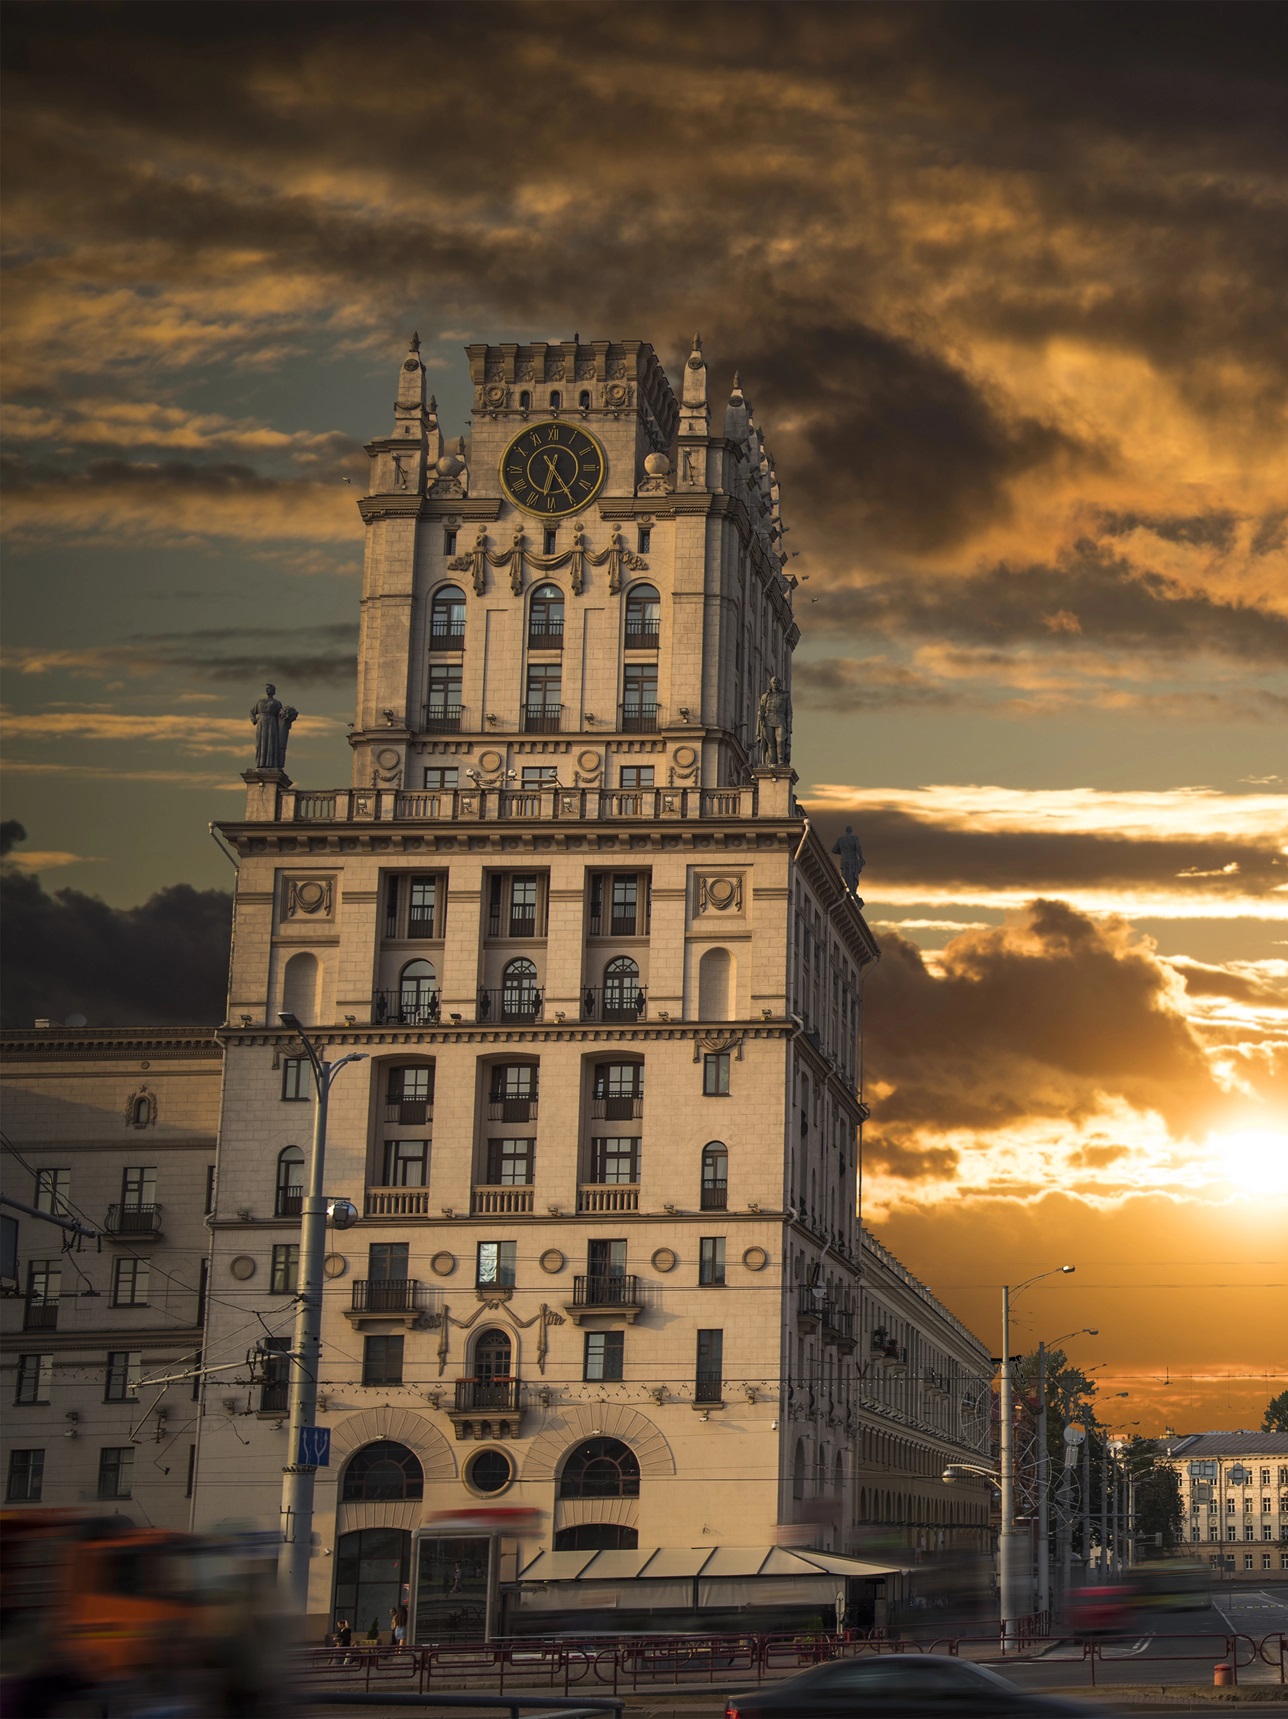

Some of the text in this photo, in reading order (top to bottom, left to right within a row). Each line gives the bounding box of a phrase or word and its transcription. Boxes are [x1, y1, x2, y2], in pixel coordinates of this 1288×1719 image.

[530, 433, 542, 446] XI
[548, 429, 559, 440] XII
[568, 433, 576, 444] I
[515, 446, 528, 457] X
[579, 446, 592, 456] II
[510, 465, 523, 474] IX
[512, 478, 528, 494] VIII
[578, 479, 591, 490] IV
[526, 491, 539, 506] VII
[547, 497, 556, 509] VI
